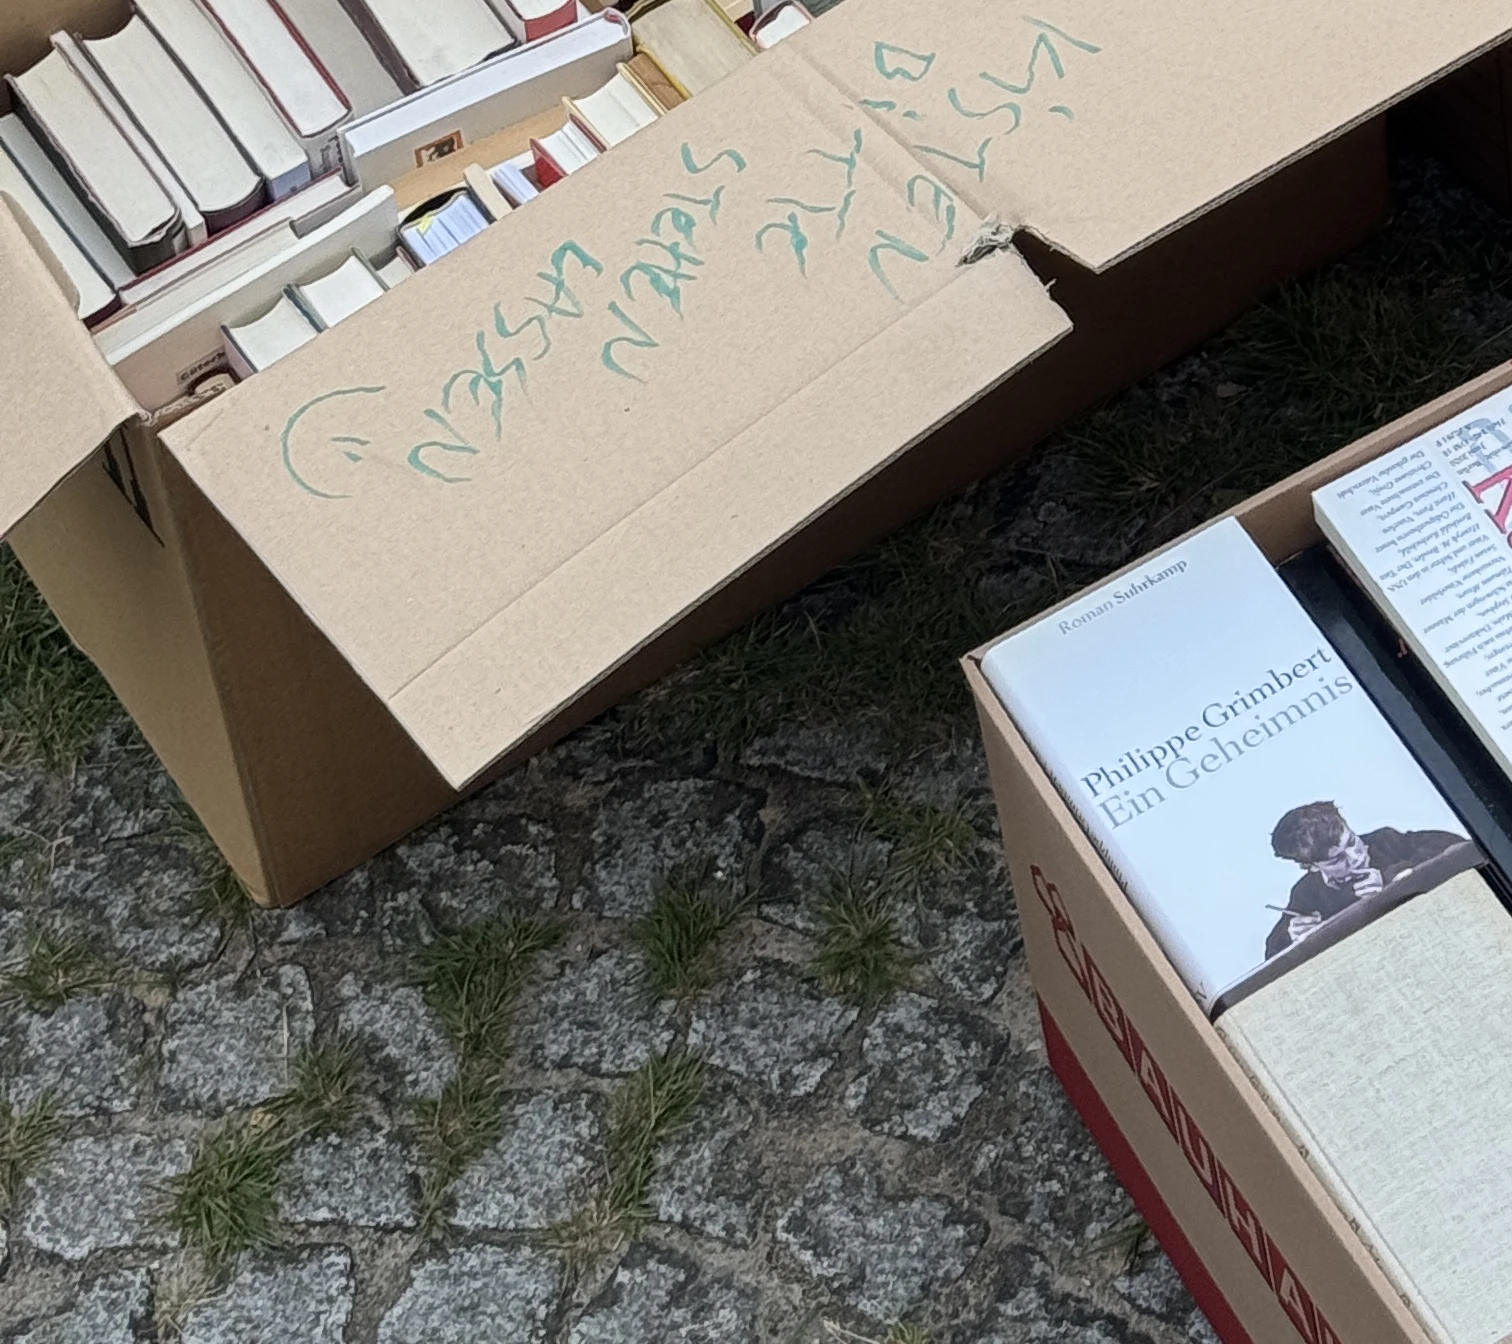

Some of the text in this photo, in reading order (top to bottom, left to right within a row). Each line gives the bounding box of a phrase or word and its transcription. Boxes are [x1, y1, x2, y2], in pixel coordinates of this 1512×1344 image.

[1057, 555, 1190, 636] Roman Suhrkamp
[1078, 642, 1336, 803] Philippe Grimbert
[1096, 667, 1360, 830] Ein Geheimnis
